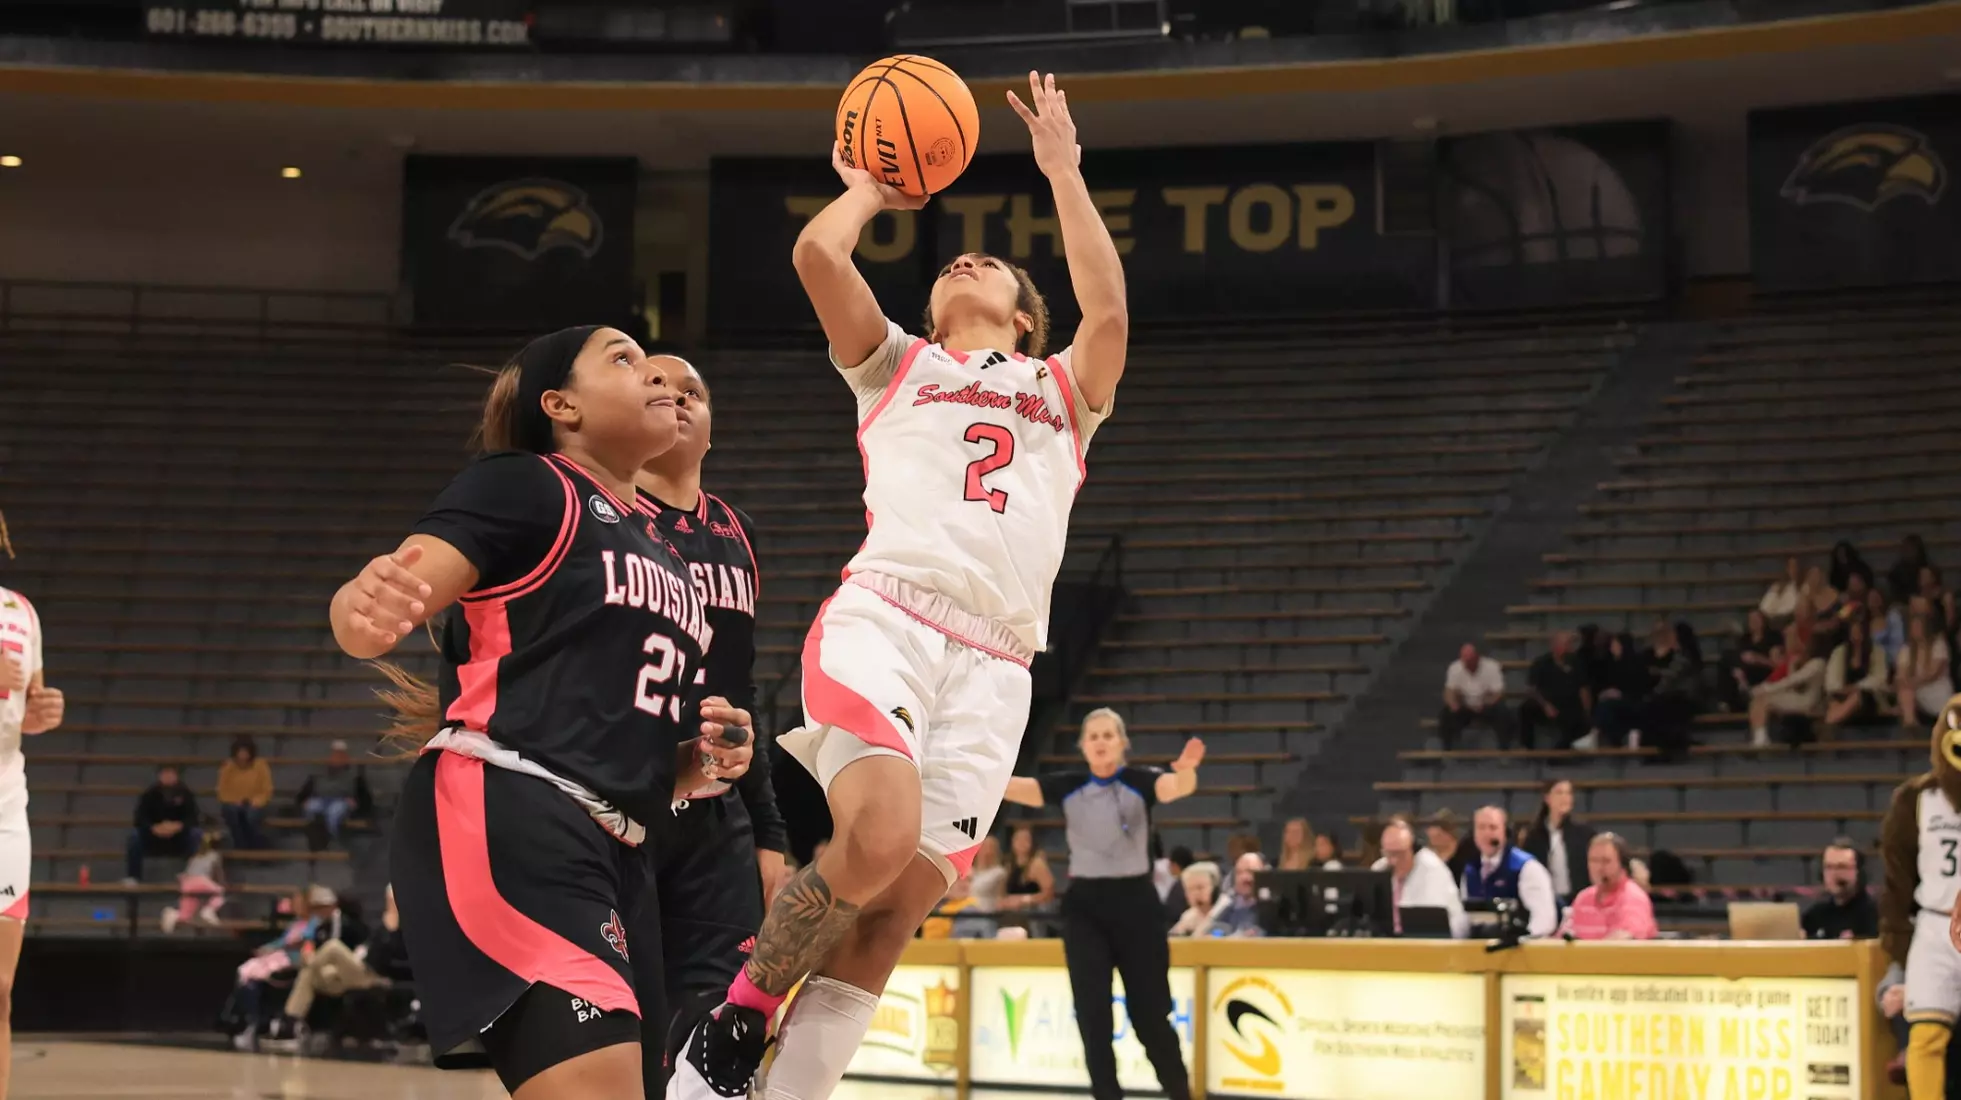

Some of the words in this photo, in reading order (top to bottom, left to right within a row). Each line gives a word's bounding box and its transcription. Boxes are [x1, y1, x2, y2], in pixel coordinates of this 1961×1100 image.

[840, 110, 858, 169] lson
[1161, 183, 1356, 253] TOP
[912, 380, 1012, 409] Southern
[1014, 391, 1065, 433] Mis
[963, 422, 1015, 515] 2
[601, 550, 706, 647] LOUISIA
[1940, 838, 1959, 878] 3
[1556, 1012, 1705, 1056] SOUTHERN
[1719, 1016, 1793, 1060] MISS
[1556, 1058, 1711, 1100] GAMEDAY
[1722, 1064, 1793, 1100] APP
